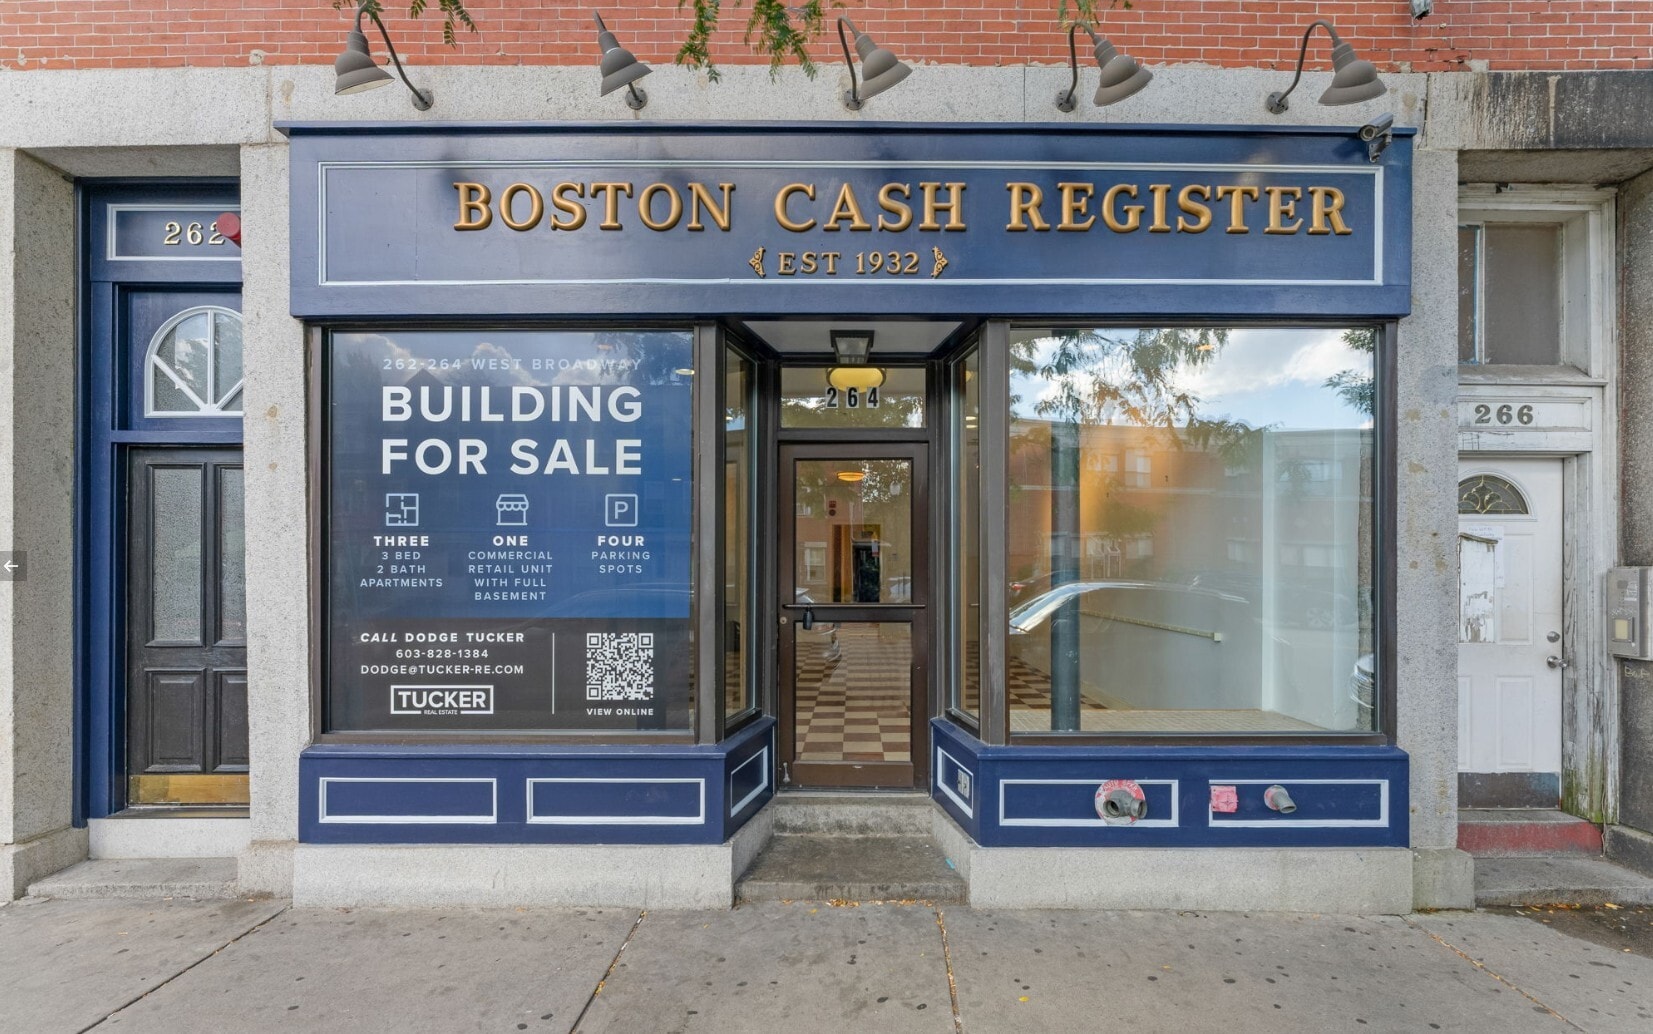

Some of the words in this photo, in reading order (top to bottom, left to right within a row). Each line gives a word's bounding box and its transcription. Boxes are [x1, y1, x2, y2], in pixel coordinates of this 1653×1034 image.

[453, 182, 736, 231] BOSTON
[774, 182, 967, 232] CASH
[1005, 182, 1353, 235] REGISTER
[777, 251, 841, 275] EST
[855, 251, 920, 275] 1932
[383, 359, 462, 370] 262-264
[472, 359, 522, 370] WEST
[532, 359, 643, 370] BROADWAY
[826, 386, 879, 408] 264
[382, 385, 642, 422] BUILDING
[1474, 404, 1534, 425] 266
[382, 438, 488, 475] FOR
[510, 438, 642, 475] SALE
[374, 536, 429, 546] THREE
[493, 535, 528, 546] ONE
[598, 535, 644, 546] FOUR
[382, 551, 388, 560] 3
[395, 551, 421, 560] BED
[468, 551, 553, 560] COMMERCIAL
[592, 551, 651, 560] PARKING
[377, 565, 384, 574] 2
[391, 565, 426, 574] BATH
[469, 565, 514, 574] RETAIL
[521, 565, 553, 574] UNIT
[599, 565, 642, 574] SPOTS
[360, 578, 443, 587] APARTMENTS
[474, 578, 509, 587] WITH
[514, 578, 546, 587] FULL
[475, 592, 546, 600] BASEMENT
[360, 633, 398, 642] CALL
[405, 633, 458, 642] DODGE
[466, 633, 524, 642] TUCKER
[396, 649, 489, 658] 603-828-1384
[361, 665, 524, 675] DODGE@TUCKER-RE.COM
[398, 691, 486, 708] TUCKER
[587, 708, 612, 716] VIEW
[616, 708, 654, 716] ONLINE
